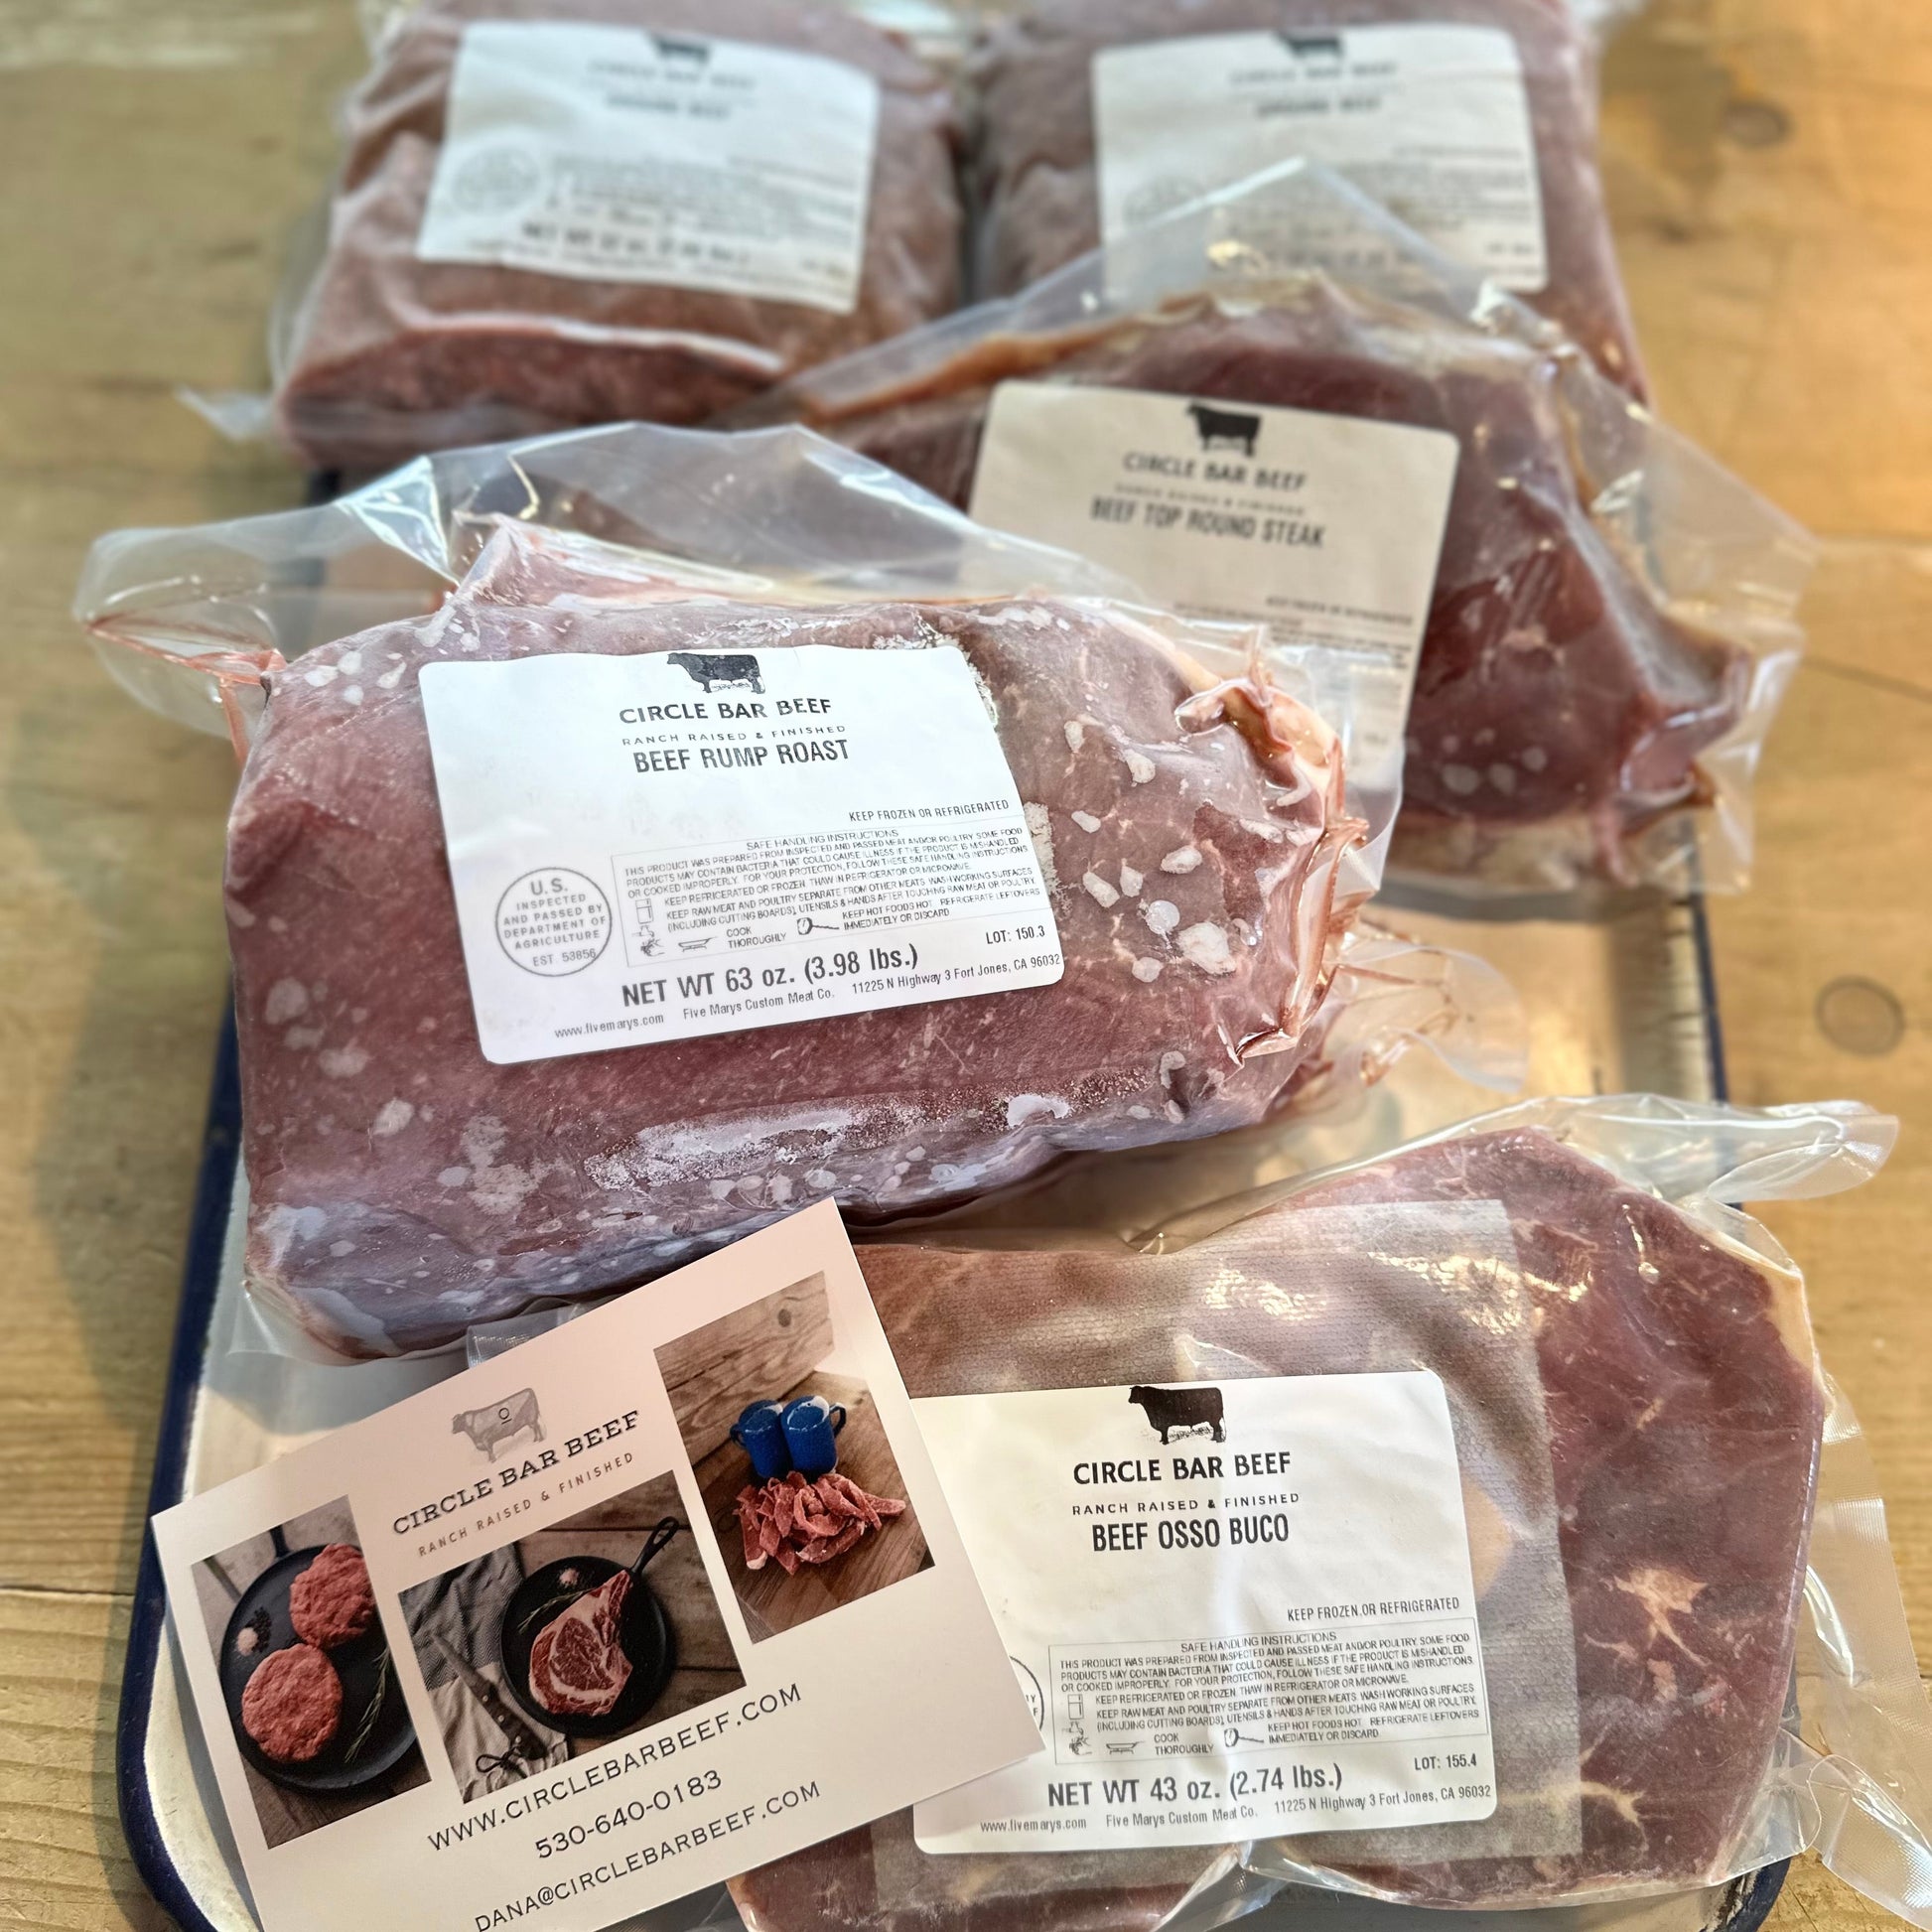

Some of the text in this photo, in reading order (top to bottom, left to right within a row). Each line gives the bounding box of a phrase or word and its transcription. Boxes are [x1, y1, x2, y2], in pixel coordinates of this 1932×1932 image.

[1204, 462, 1247, 483] BAR
[1254, 468, 1306, 491] BEEF
[1091, 497, 1135, 523] BEEF
[1144, 502, 1182, 528] TOP
[1186, 508, 1256, 540] ROUND
[1262, 519, 1325, 547] STEAK
[619, 697, 831, 724] CIRCLE BAR BEEF
[621, 734, 679, 746] RANCH
[770, 725, 845, 738] FINISHED
[632, 739, 848, 773] BEEF RUMP ROAST
[848, 799, 1009, 822] KEEP FROZEN OR REFRIGERATED
[530, 878, 568, 896] U.S.
[503, 903, 603, 926] AND PASSED BY
[516, 894, 586, 911] INSPECTED
[504, 916, 607, 939] DEPARTMENT OF
[515, 929, 601, 950] AGRICULTURE
[985, 924, 1045, 944] LOT: 150.3
[532, 954, 554, 967] EST
[621, 942, 918, 1007] NET WT 63 oz. (3.98 lbs.)
[682, 1008, 706, 1020] Five
[709, 1003, 742, 1016] Marys
[745, 996, 783, 1011] Custom
[787, 990, 814, 1004] Meat
[852, 979, 885, 994] 11225
[886, 977, 895, 989] N
[897, 973, 941, 989] Highway
[944, 969, 951, 981] 3
[953, 966, 974, 979] Fort
[1013, 957, 1028, 971] CA
[1030, 953, 1060, 968] 96032
[393, 1410, 639, 1535] CIRCLE BAR BEEF
[1073, 1450, 1291, 1485] CIRCLE BAR BEEF
[418, 1451, 633, 1557] RANCH RAISED & FINISHED
[1072, 1492, 1299, 1516] RANCH RAISED & FINISHED
[1092, 1513, 1289, 1552] BEEF OSSO BUCO
[1287, 1607, 1314, 1621] KEEP
[1361, 1602, 1377, 1616] OR
[1379, 1596, 1459, 1614] REFRIGERATED
[1153, 1731, 1179, 1743] COOK
[1155, 1742, 1214, 1755] THOROUGHLY
[428, 1683, 802, 1851] WWW.CIRCLEBARBEEF.COM
[1414, 1752, 1477, 1771] LOT: 155.4
[1047, 1762, 1342, 1807] NET WT 43 oz. (2.74 lbs.)
[534, 1769, 723, 1859] 530-640-0183
[1105, 1814, 1129, 1828] Five
[1132, 1812, 1166, 1829] Marys
[1168, 1811, 1208, 1825] Custom
[1211, 1807, 1237, 1822] Meat
[1274, 1797, 1307, 1814] 11225
[1309, 1797, 1316, 1810] N
[1319, 1795, 1366, 1813] Highway
[1368, 1793, 1376, 1807] 3
[1378, 1792, 1400, 1806] Fort
[1440, 1786, 1455, 1800] CA
[1457, 1784, 1491, 1799] 96032
[475, 1781, 821, 1932] DANA@CIRCLEBARBEEF.COM
